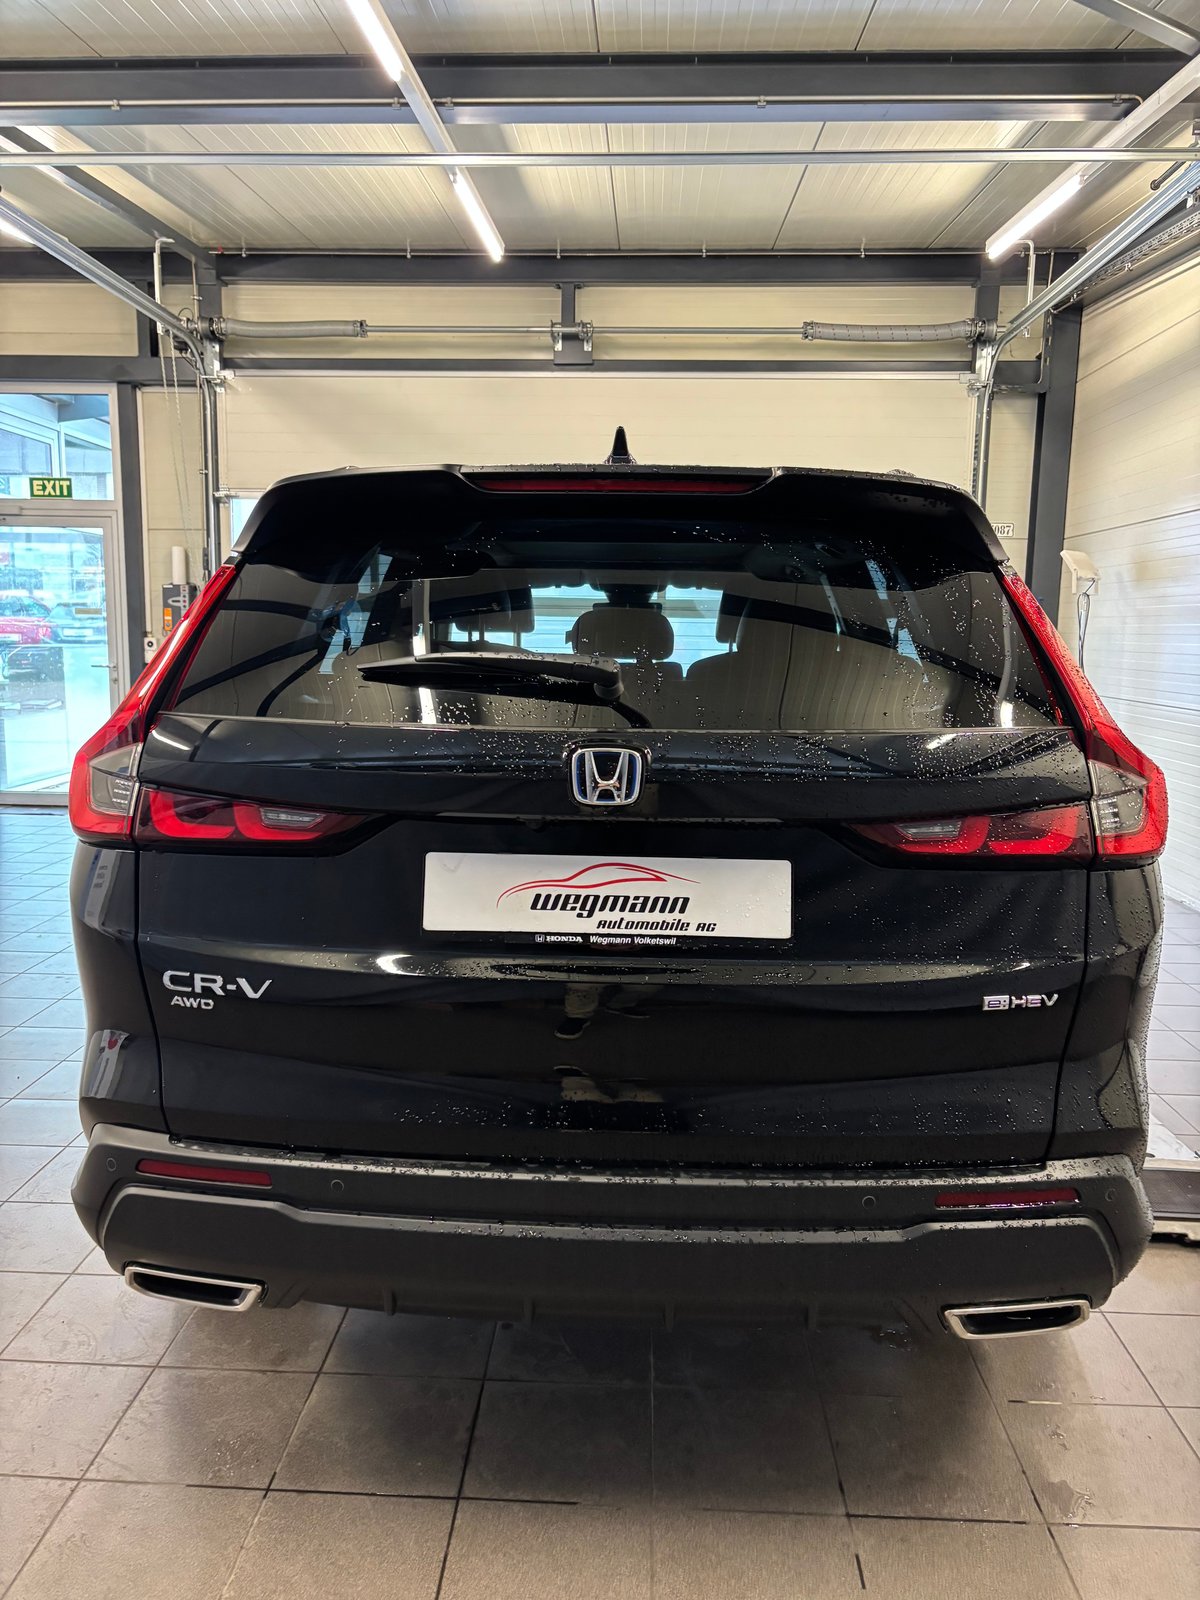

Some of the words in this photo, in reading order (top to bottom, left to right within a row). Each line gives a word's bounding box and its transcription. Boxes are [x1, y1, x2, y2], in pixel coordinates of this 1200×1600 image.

[32, 480, 70, 496] EXIT
[991, 524, 1012, 536] 087
[530, 893, 690, 918] wegmann
[695, 922, 717, 932] AG
[545, 935, 583, 943] HONDA
[589, 935, 632, 945] Wegmann
[634, 936, 677, 945] Volketswil
[162, 970, 273, 999] CR-V
[170, 995, 215, 1010] AWD
